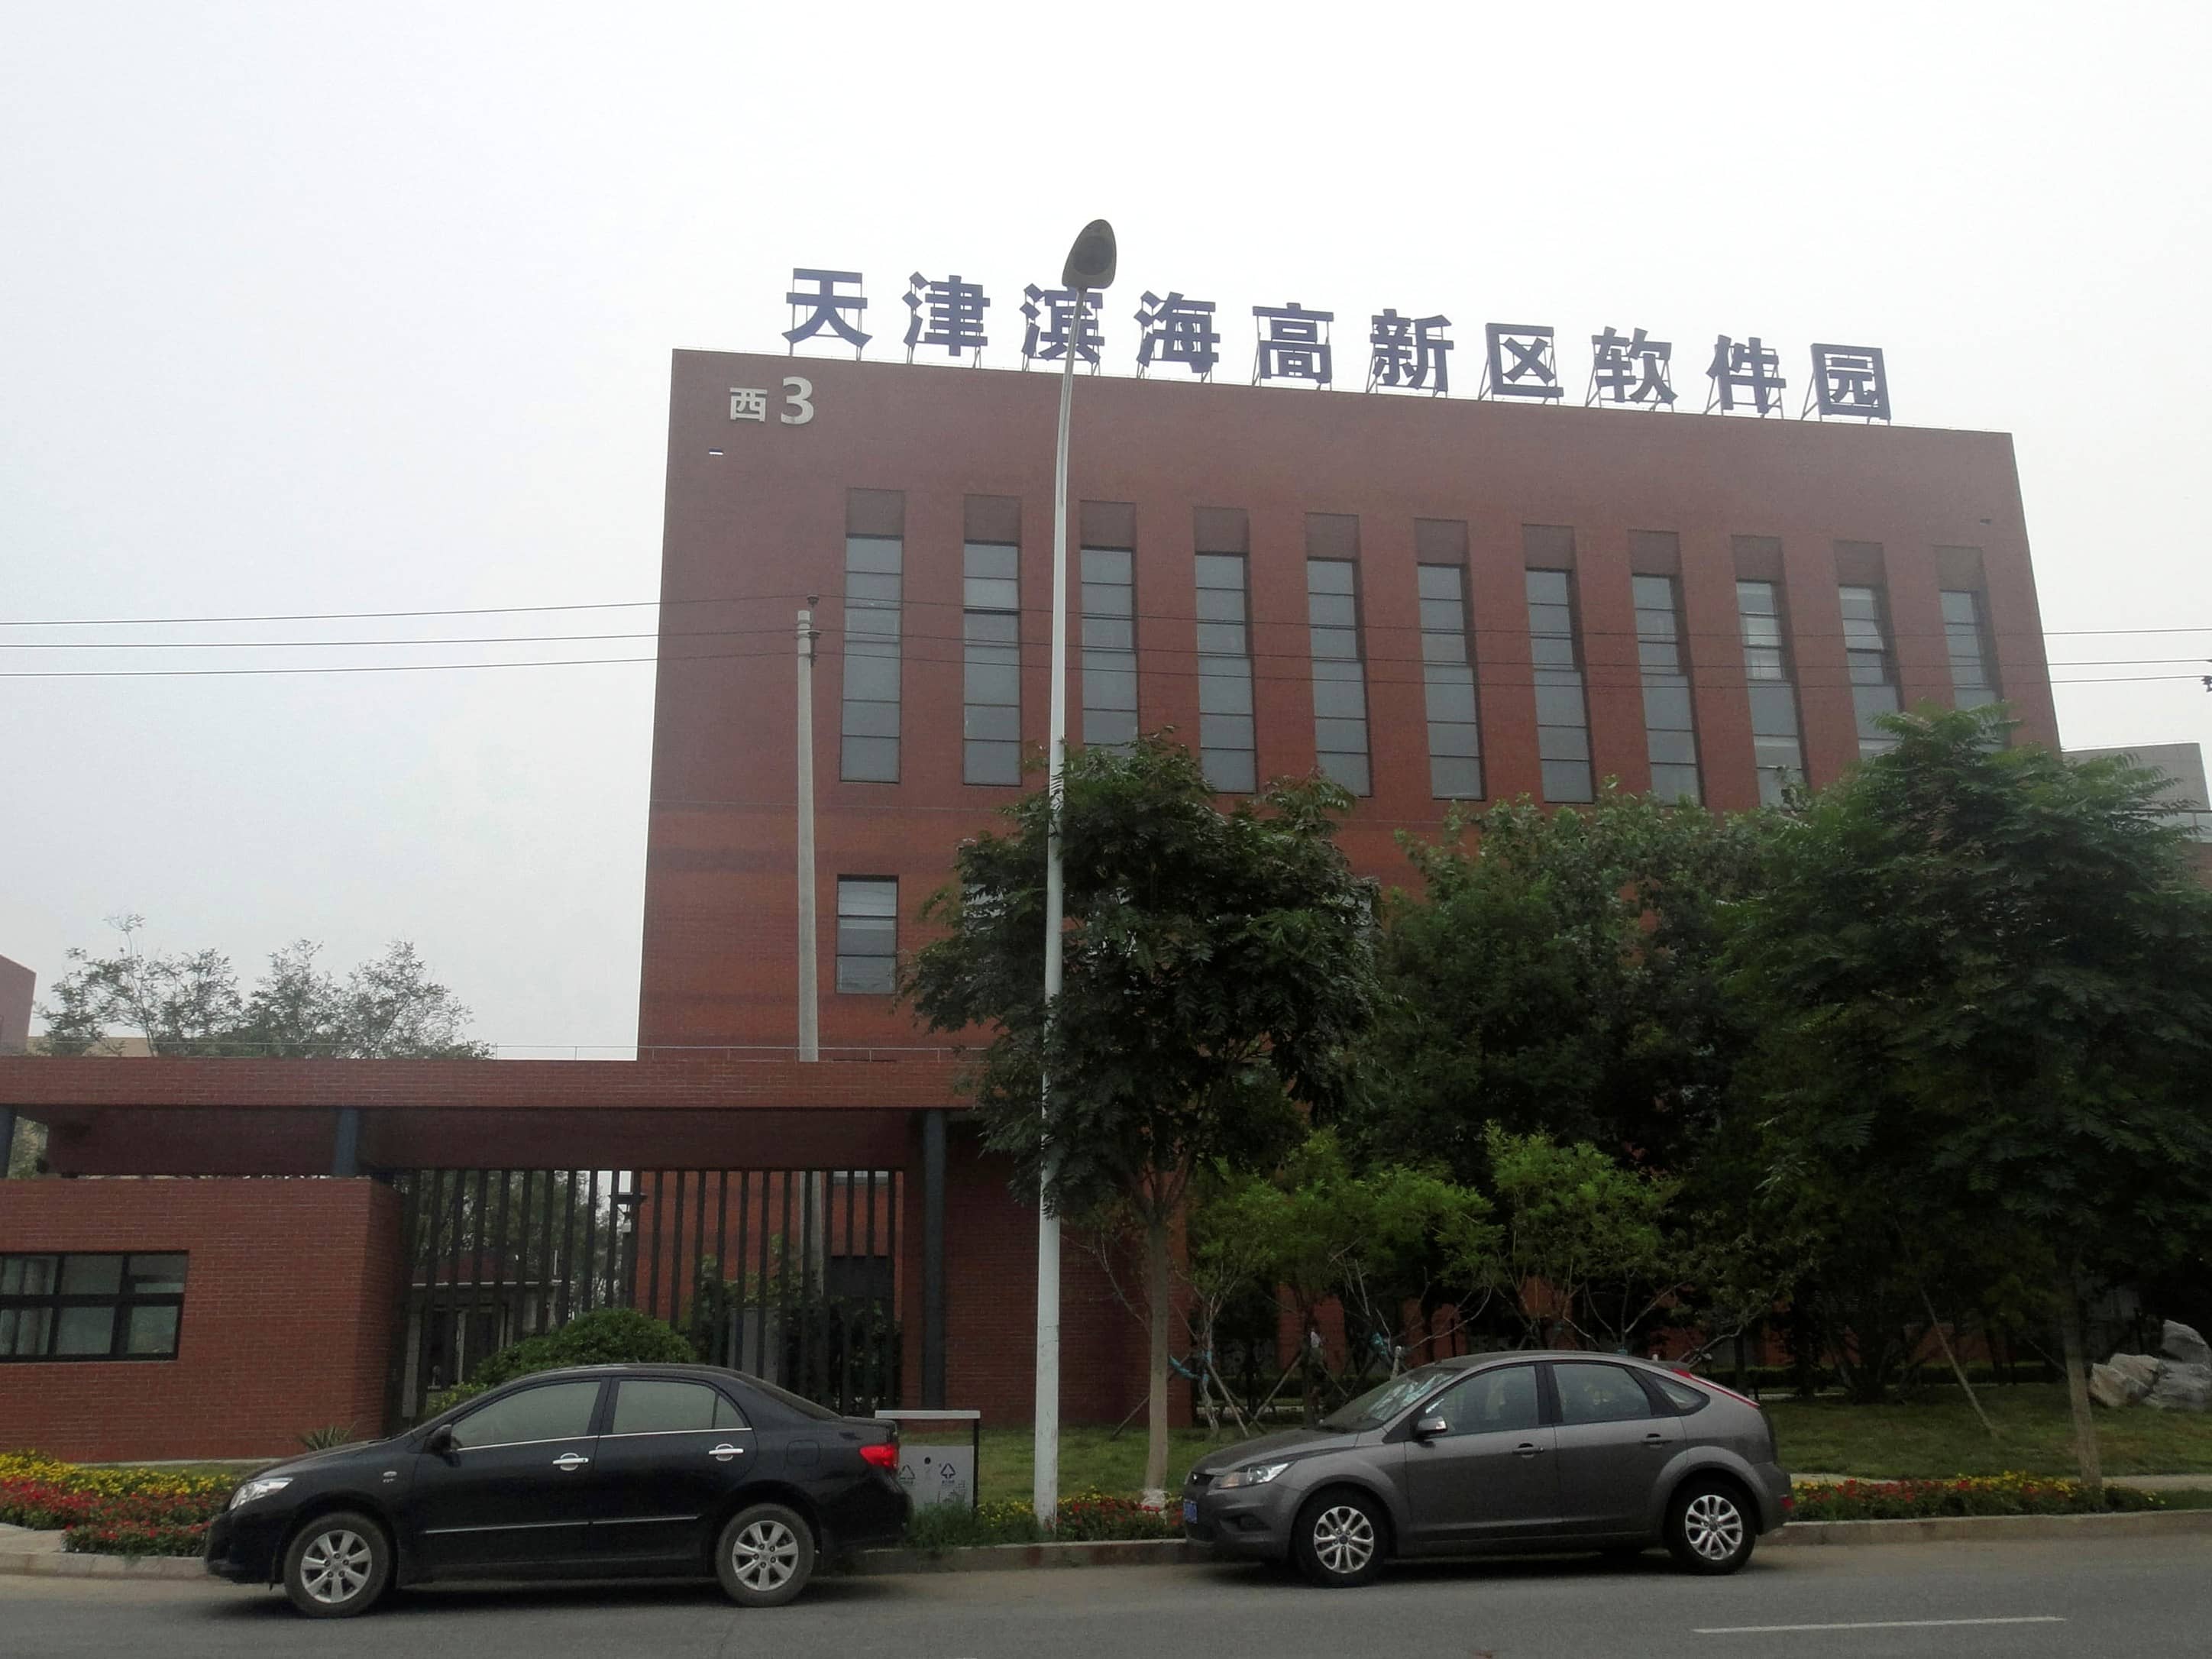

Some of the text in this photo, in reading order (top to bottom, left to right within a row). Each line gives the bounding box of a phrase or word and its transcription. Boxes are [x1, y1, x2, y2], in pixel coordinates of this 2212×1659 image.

[781, 268, 1891, 420] 天津滨海高新区软件园
